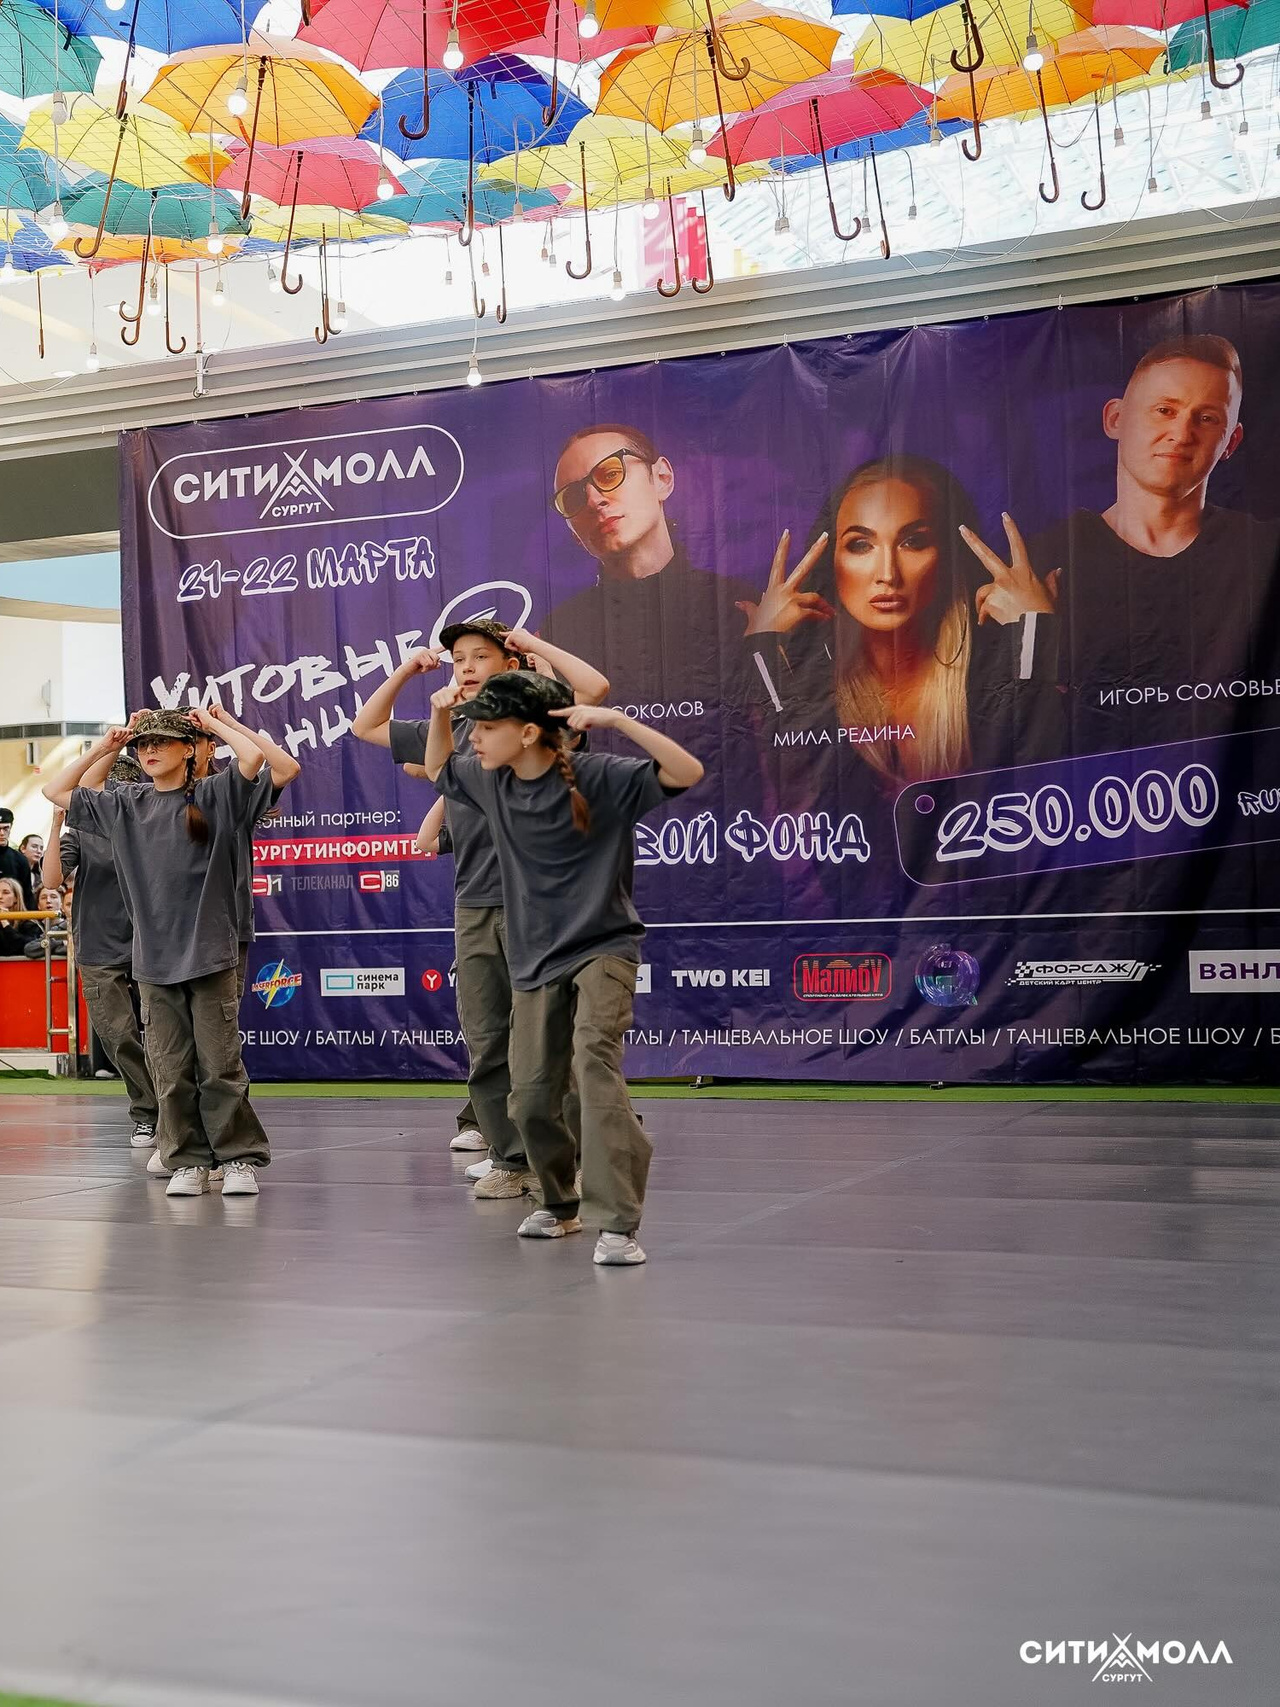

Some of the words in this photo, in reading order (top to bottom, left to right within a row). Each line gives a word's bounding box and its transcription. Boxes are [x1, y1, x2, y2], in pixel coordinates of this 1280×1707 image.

[173, 462, 278, 504] СИТИ
[313, 445, 436, 488] МОЛЛ
[271, 501, 322, 518] СУРГУТ
[177, 554, 299, 602] 21-22
[307, 535, 435, 589] МАРТА
[1099, 686, 1170, 706] ИГОРЬ
[773, 729, 831, 747] МИЛА
[837, 724, 916, 744] РЕДИНА
[320, 809, 401, 829] партнер:
[936, 763, 1220, 862] 250.000
[724, 809, 871, 864] ФОНД
[291, 874, 354, 891] ТЕЛЕКАНАЛ
[356, 973, 399, 982] синема
[671, 969, 726, 987] TWO
[732, 968, 770, 987] KEI
[1035, 963, 1130, 974] ФОРСАЖ
[356, 981, 385, 991] парк
[259, 1030, 300, 1046] ШОУ
[315, 1030, 375, 1045] БАТТЛЫ
[681, 1029, 833, 1047] ТАНЦЕВАЛЬНОЕ
[838, 1028, 889, 1046] ШОУ
[909, 1028, 986, 1046] БАТТЛЫ
[1006, 1027, 1181, 1047] ТАНЦЕВАЛЬНОЕ
[1187, 1027, 1246, 1045] ШОУ
